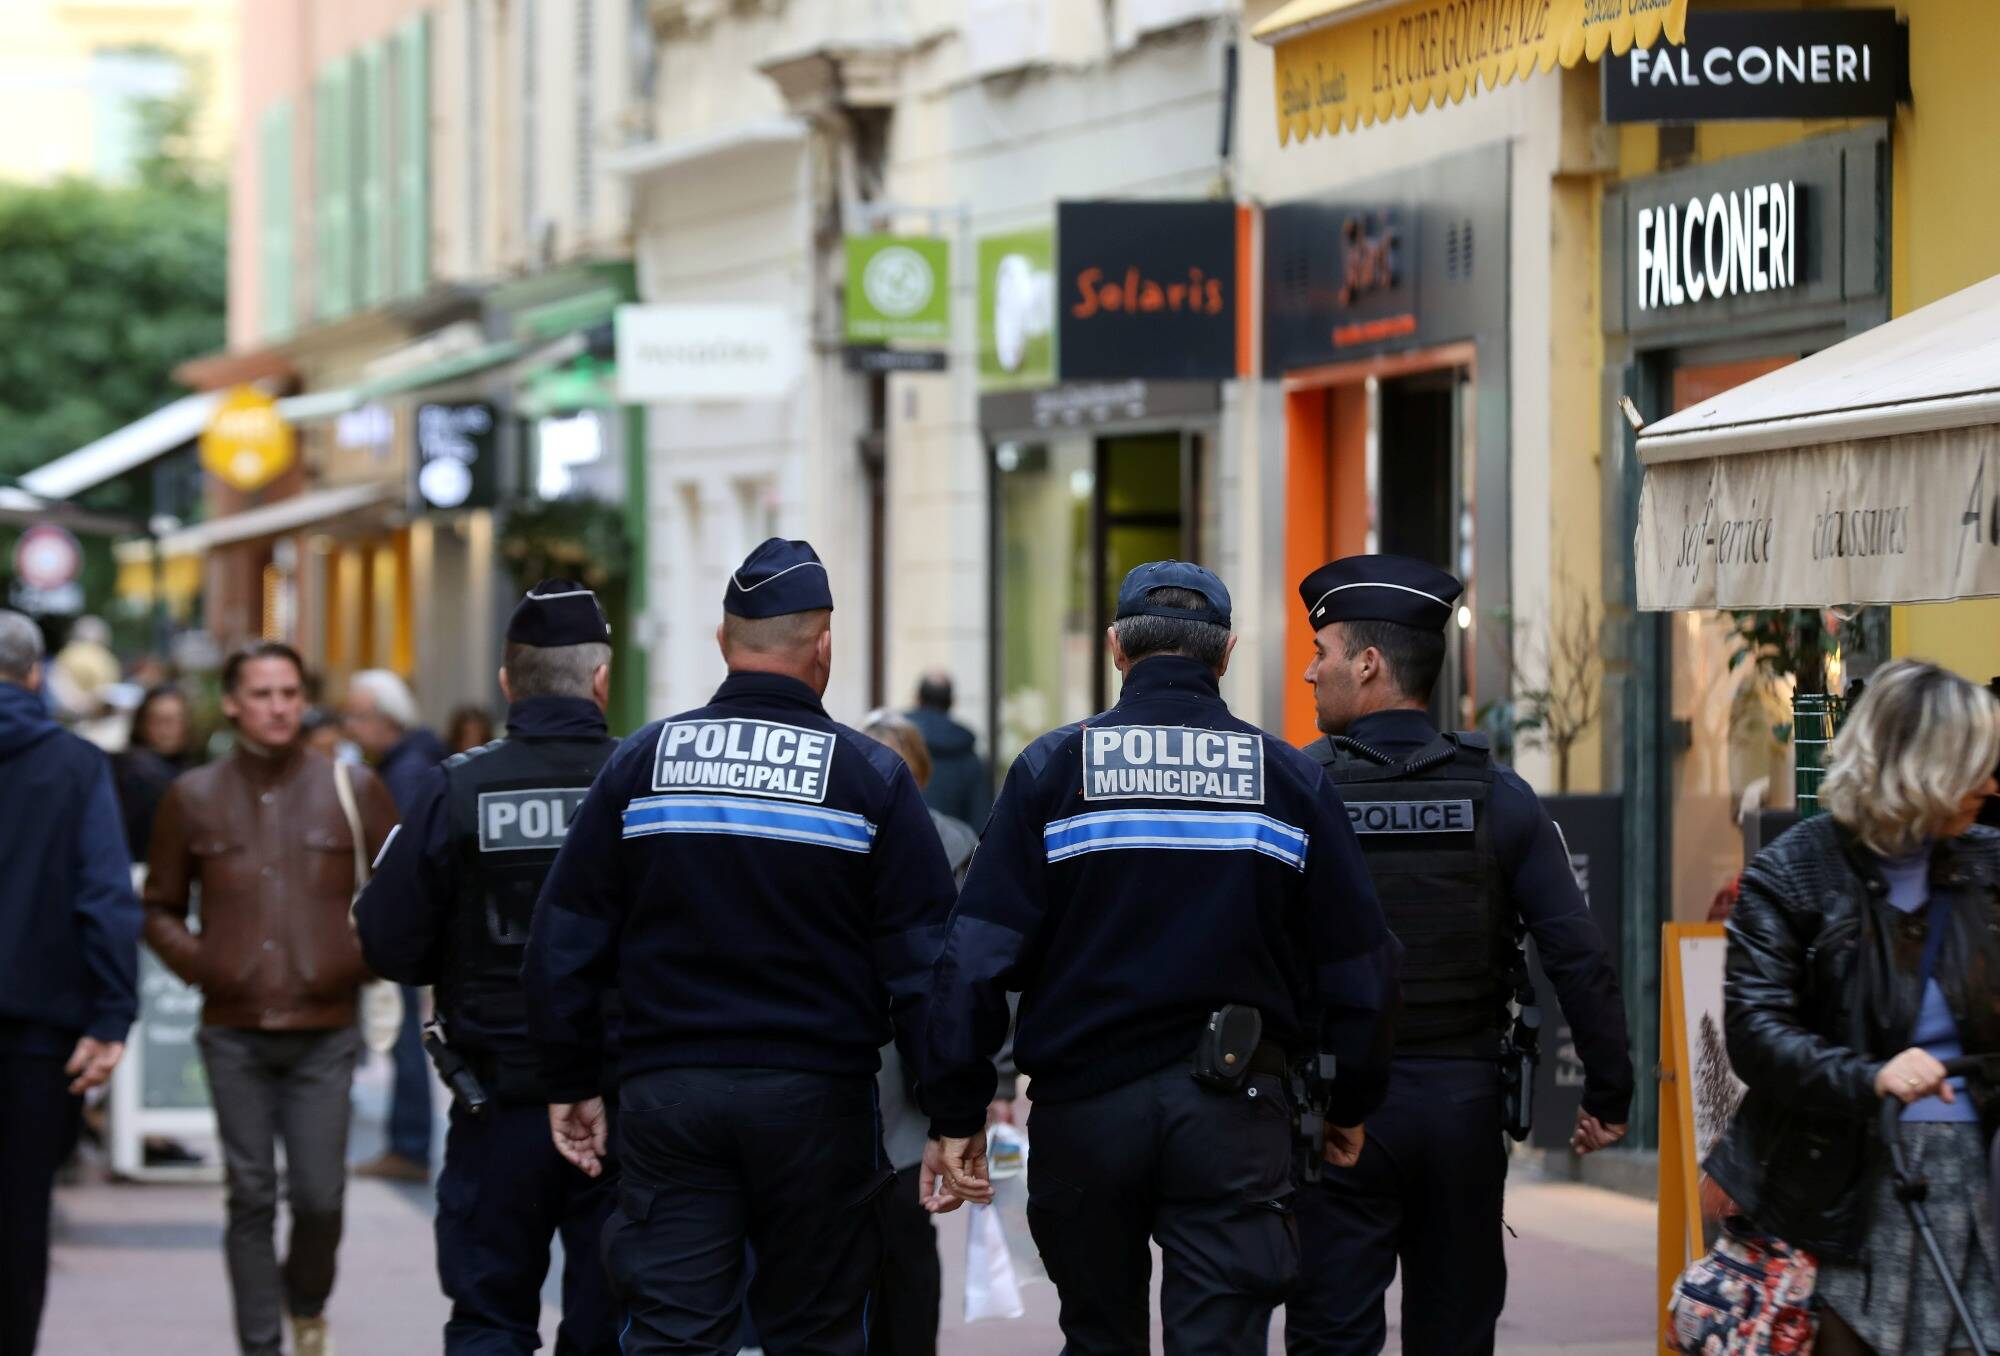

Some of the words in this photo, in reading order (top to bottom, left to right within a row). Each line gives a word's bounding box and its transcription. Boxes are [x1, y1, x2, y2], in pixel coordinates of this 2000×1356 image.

[1630, 44, 1872, 86] FALCONERI
[1638, 181, 1795, 309] FALCONERI
[1072, 266, 1223, 319] Solaris
[664, 723, 826, 768] POLICE
[1093, 728, 1253, 770] POLICE
[661, 760, 818, 796] MUNICIPALE
[1094, 768, 1254, 798] MUNICIPALE
[488, 799, 584, 839] POL
